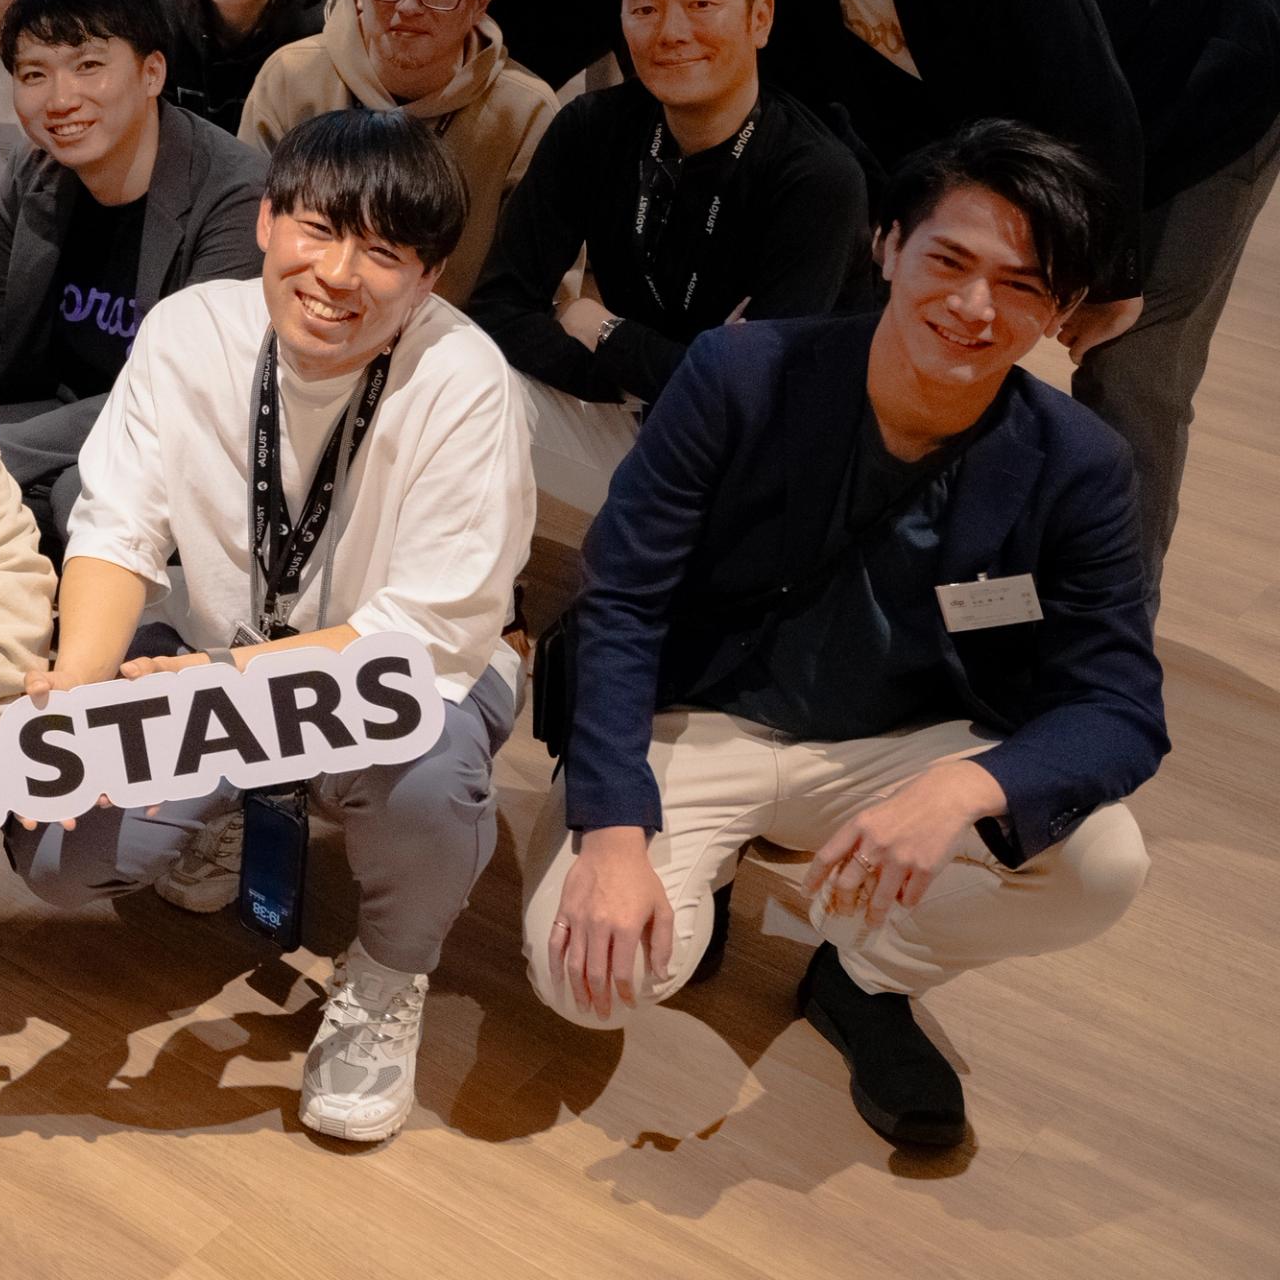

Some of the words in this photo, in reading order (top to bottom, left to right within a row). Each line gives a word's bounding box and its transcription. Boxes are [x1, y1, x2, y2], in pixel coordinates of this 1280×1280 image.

[732, 121, 755, 159] ADJUST
[635, 195, 649, 234] ADJUST
[366, 368, 384, 407] ADJUST
[259, 429, 268, 468] ADJUST
[20, 655, 428, 799] STARS
